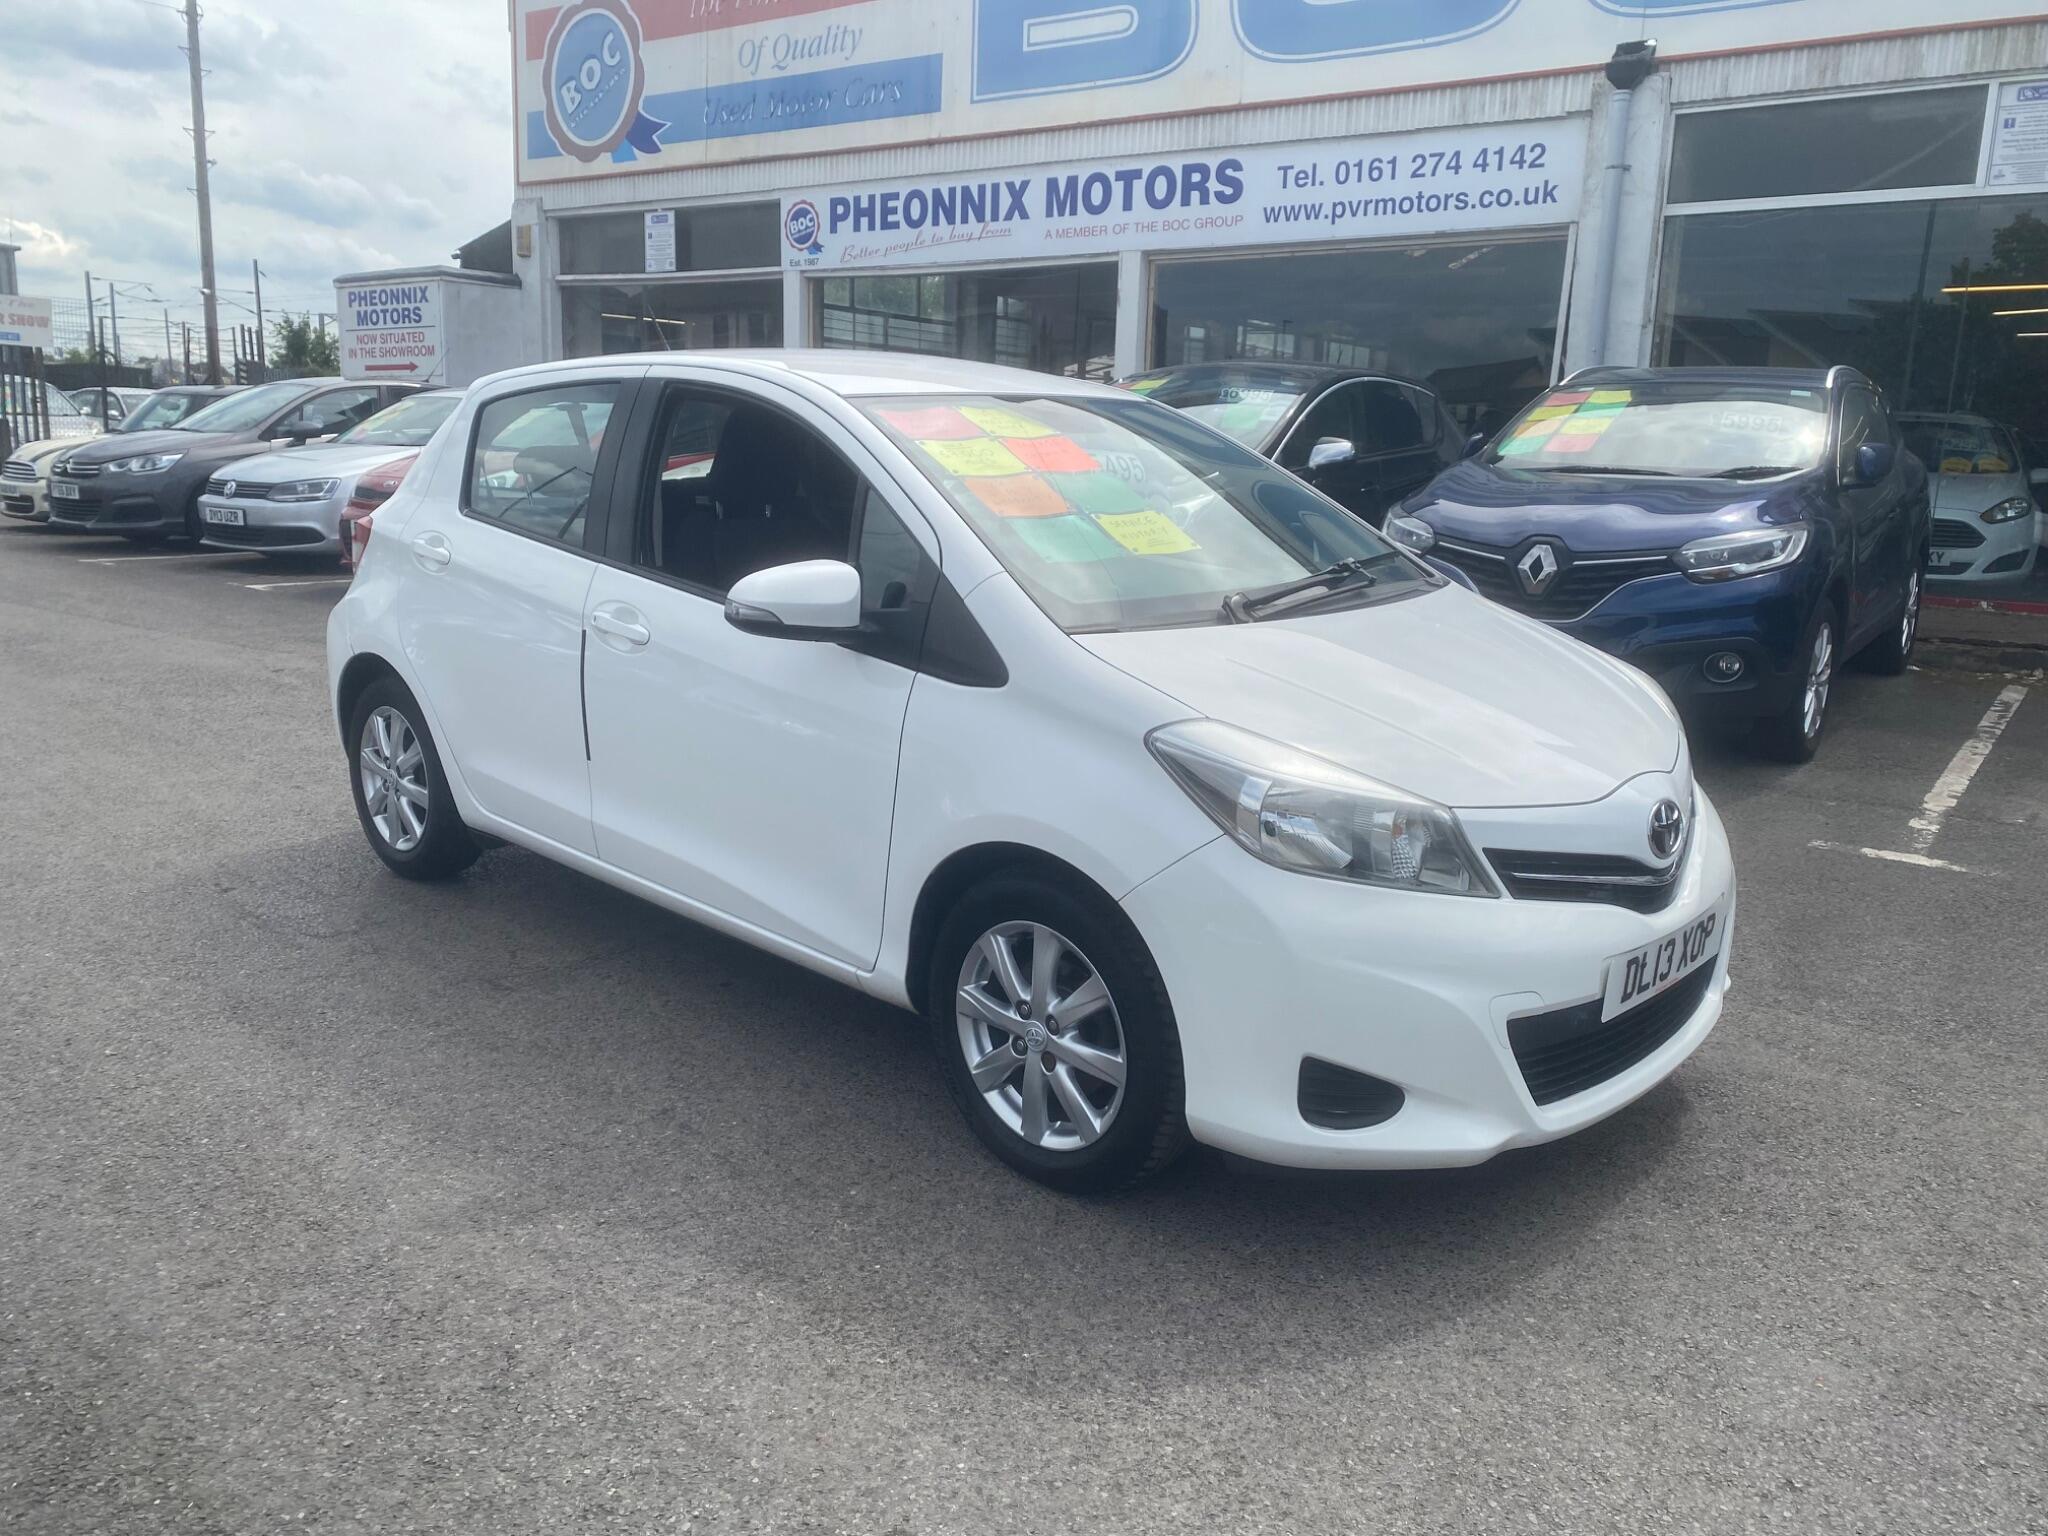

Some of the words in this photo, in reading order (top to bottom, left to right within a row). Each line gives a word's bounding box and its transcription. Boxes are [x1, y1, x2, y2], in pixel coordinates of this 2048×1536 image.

[738, 37, 768, 75] Of
[772, 24, 863, 70] Quality
[560, 31, 621, 114] BOC
[703, 93, 757, 126] Used
[762, 88, 836, 120] Motor
[845, 78, 903, 109] Cars
[1277, 163, 1325, 189] Tel.
[1335, 156, 1398, 185] 0161
[1410, 150, 1462, 179] 274
[1472, 142, 1547, 173] 4142
[829, 179, 1031, 234] PHEONNIX
[1045, 158, 1244, 218] MOTORS
[1263, 180, 1559, 225] www.pvrmotors.co.uk
[790, 213, 815, 234] BOC
[840, 244, 880, 263] Better
[884, 230, 926, 257] people
[931, 232, 943, 244] to
[949, 226, 973, 242] buy
[977, 221, 1011, 240] from
[1044, 230, 1053, 240] A
[1056, 225, 1108, 239] MEMBER
[1112, 223, 1129, 235] OF
[1134, 221, 1158, 233] THE
[1162, 219, 1190, 232] BOC
[1194, 215, 1244, 229] GROUP
[348, 286, 429, 308] PHEONNIX
[356, 306, 422, 327] MOTORS
[348, 347, 357, 359] IN
[360, 346, 377, 358] THE
[379, 344, 434, 358] SHOWROOM
[356, 334, 377, 345] NOW
[379, 331, 425, 344] SITUATED
[1621, 938, 1676, 1004] DL13
[1676, 912, 1716, 973] XOP
